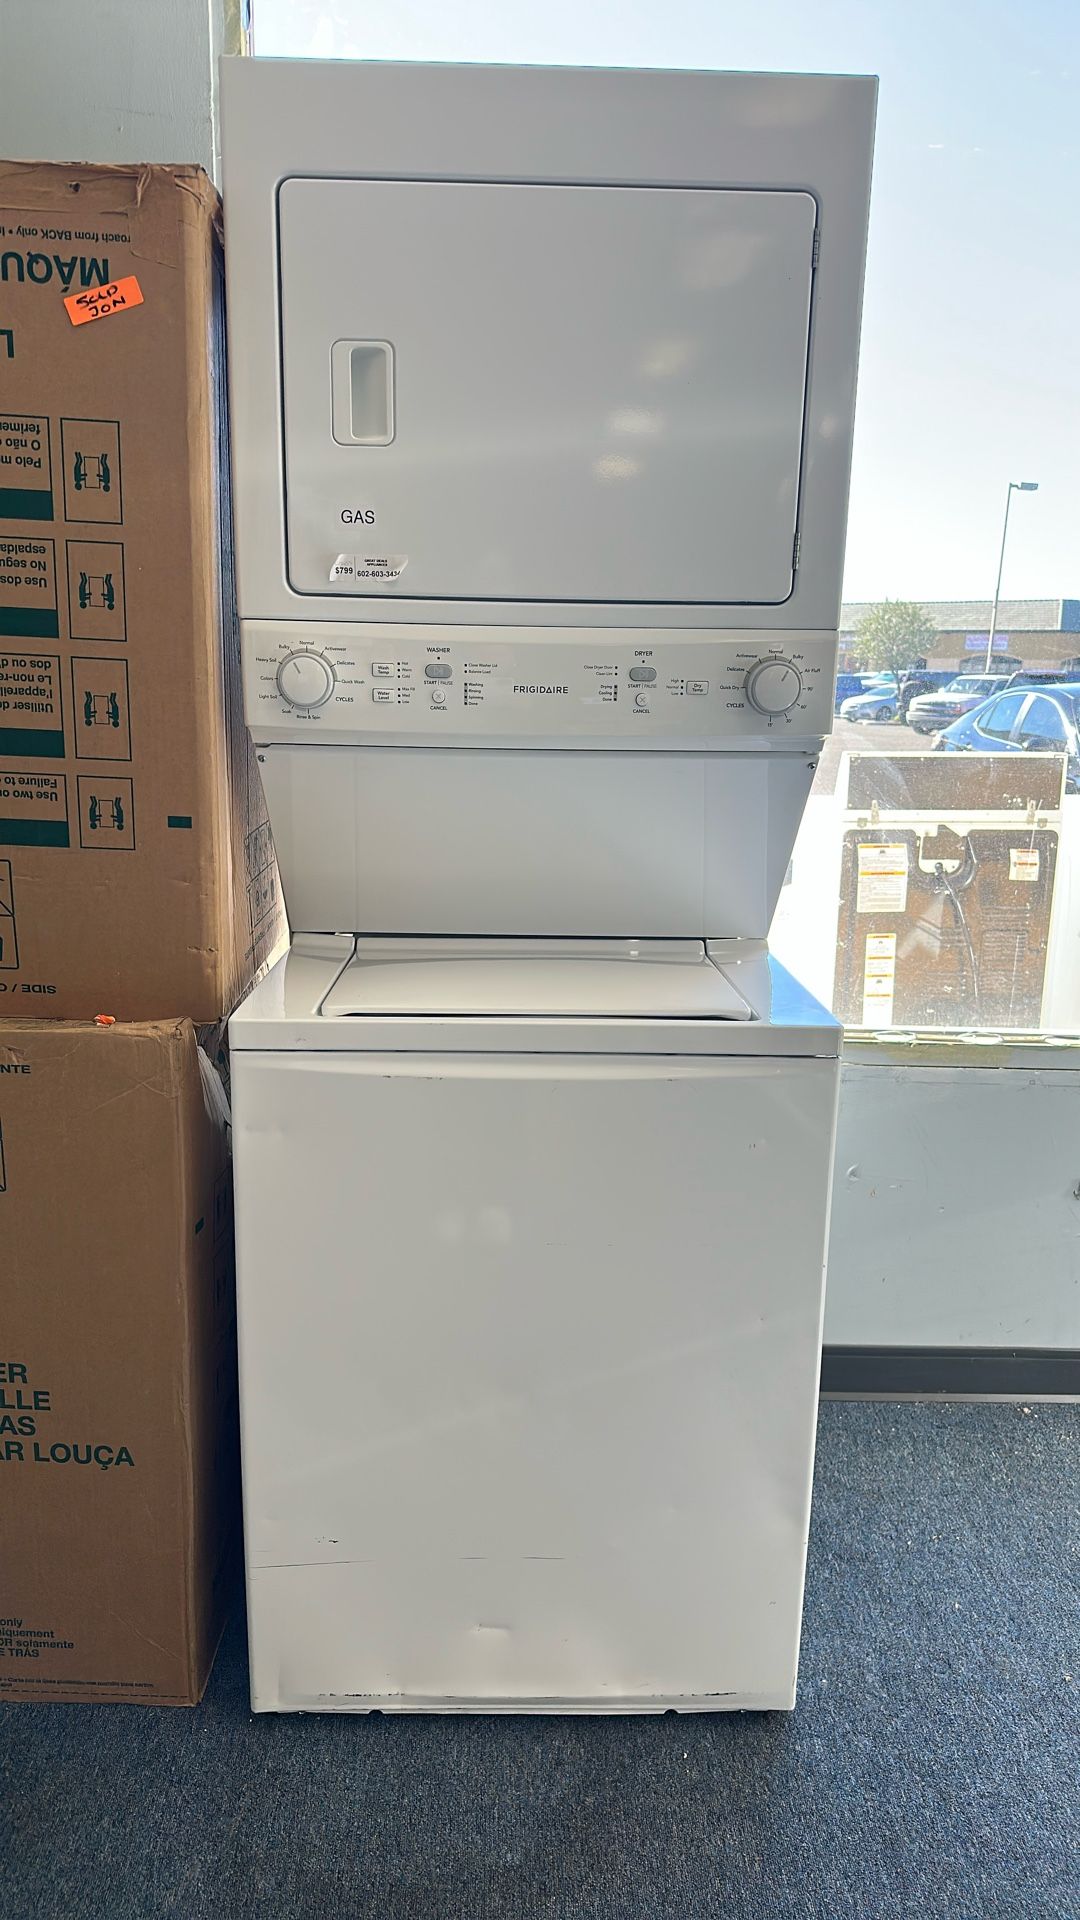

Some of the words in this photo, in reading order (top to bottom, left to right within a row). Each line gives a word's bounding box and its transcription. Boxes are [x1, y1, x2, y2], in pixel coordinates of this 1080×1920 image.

[16, 225, 38, 238] only
[41, 228, 72, 241] BACK
[75, 231, 99, 242] from
[1, 251, 109, 294] MÁQU
[88, 295, 126, 318] JON
[5, 437, 28, 450] não
[30, 439, 41, 451] O
[15, 455, 42, 469] Pelo
[341, 509, 376, 525] GAS
[0, 542, 46, 555] espalda
[0, 556, 27, 569] segu
[30, 559, 47, 572] No
[335, 566, 354, 575] $799
[0, 574, 22, 586] dos
[24, 576, 47, 588] Use
[12, 658, 27, 668] ou
[30, 660, 52, 671] dos
[37, 674, 52, 686] Le
[513, 685, 569, 694] FRIGIDAIRE
[12, 701, 54, 713] Utiliser
[4, 776, 16, 786] to
[18, 776, 57, 789] Failure
[12, 790, 34, 801] two
[36, 791, 58, 802] Use
[21, 983, 57, 994] SIDE
[0, 1415, 36, 1436] AS
[0, 1441, 24, 1461] R
[33, 1442, 135, 1471] LOUÇA
[0, 1617, 23, 1628] only
[16, 1639, 75, 1650] solamente
[8, 1647, 40, 1658] TRÁS
